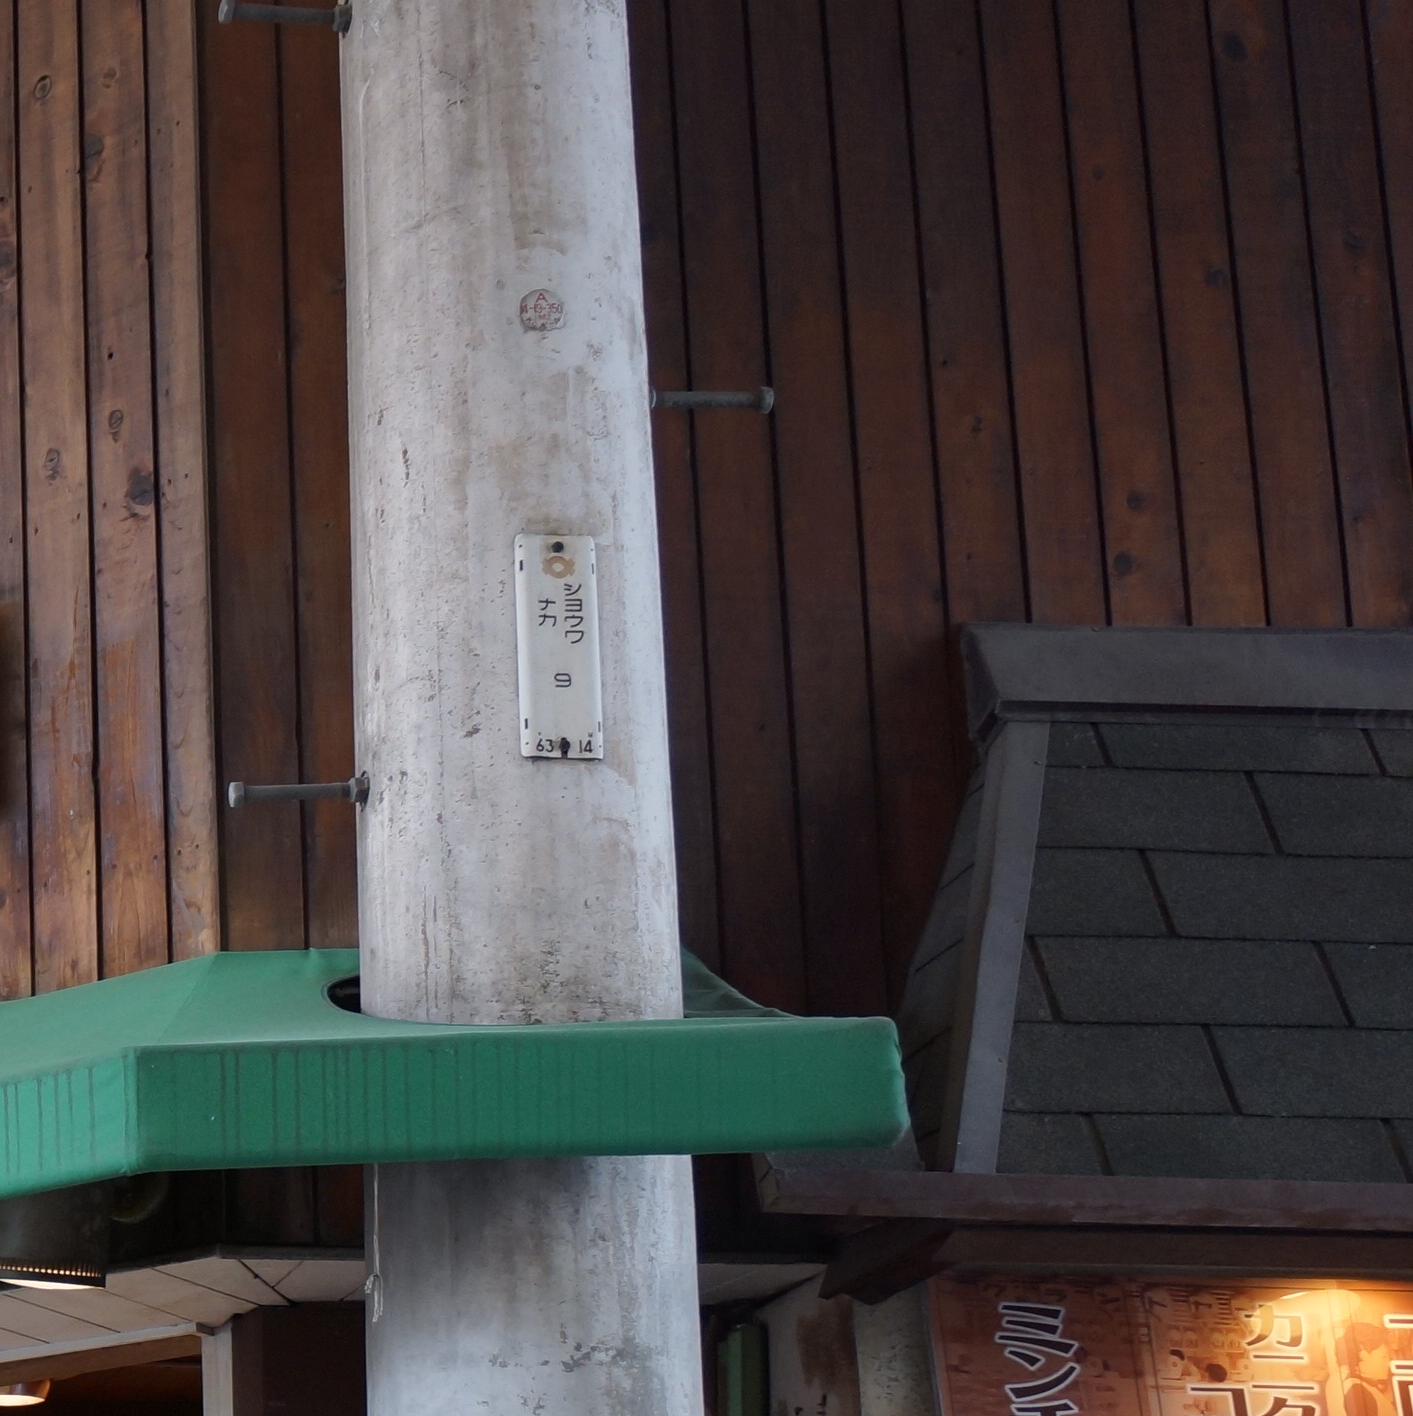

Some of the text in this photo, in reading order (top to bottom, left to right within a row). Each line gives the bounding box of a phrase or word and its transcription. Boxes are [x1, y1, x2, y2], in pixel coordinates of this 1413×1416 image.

[537, 598, 557, 628] ナカ
[536, 738, 594, 753] 63 14
